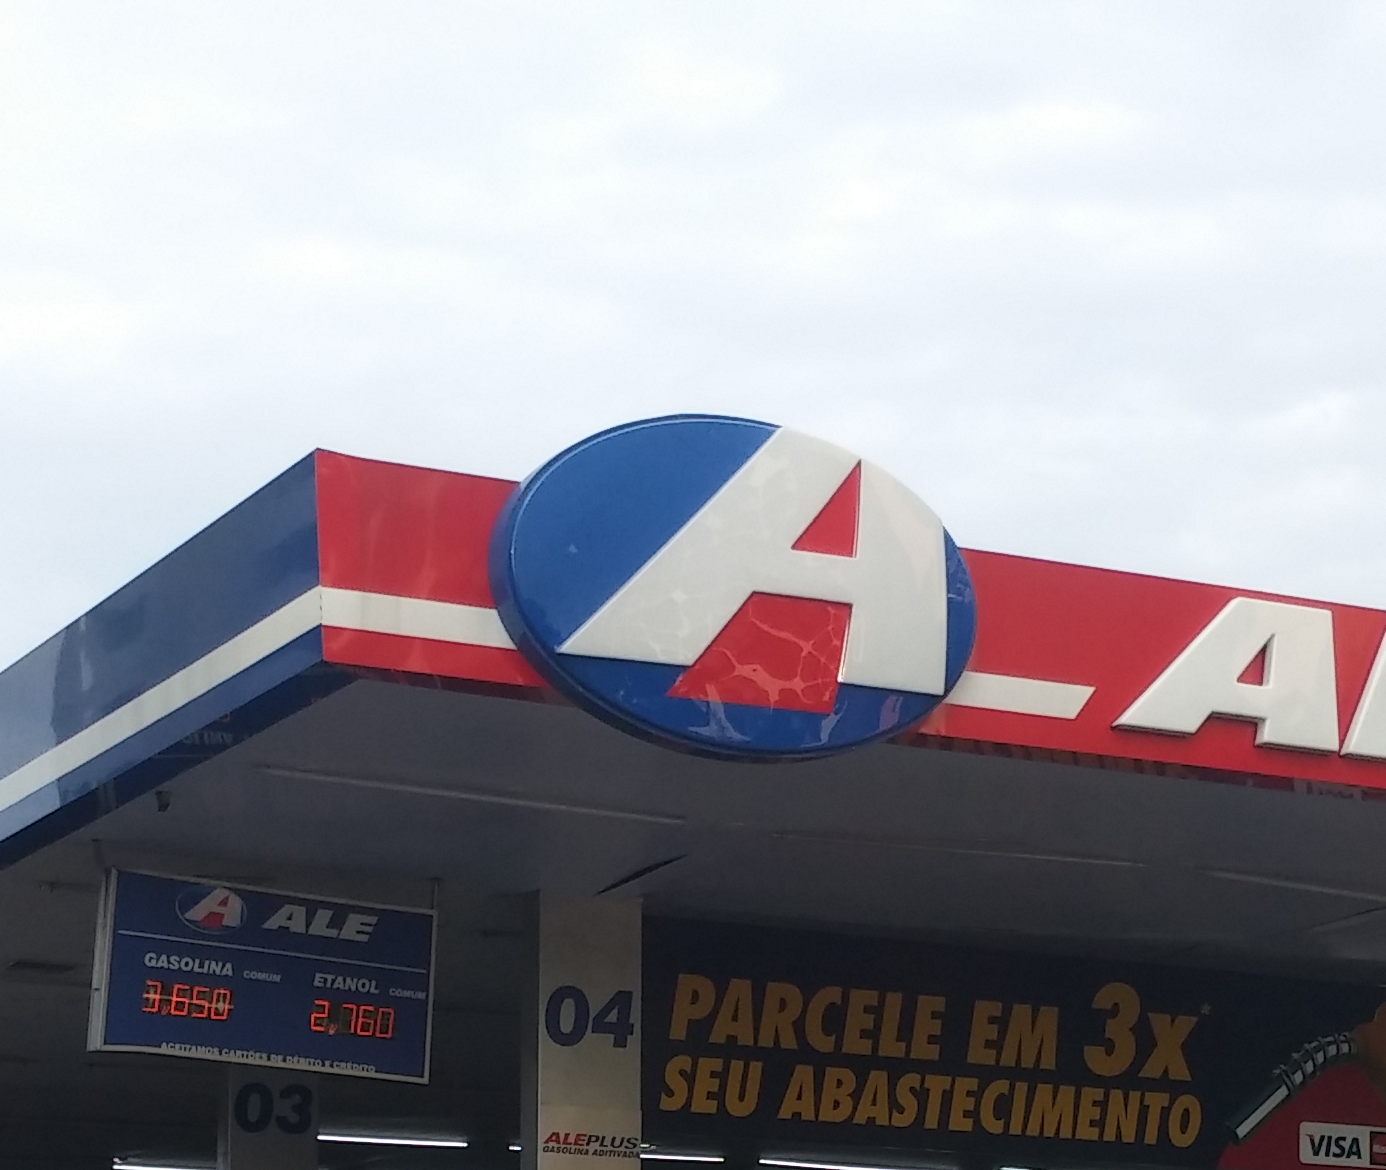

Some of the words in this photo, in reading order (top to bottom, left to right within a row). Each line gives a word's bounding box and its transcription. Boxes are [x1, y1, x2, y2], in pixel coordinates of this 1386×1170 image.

[261, 904, 379, 942] ALE
[144, 951, 234, 977] GASOLINA
[243, 969, 281, 983] COMUM
[314, 973, 380, 995] ETANOL
[389, 988, 427, 1000] COMUM
[545, 985, 634, 1048] 04
[668, 973, 943, 1061] PARCELE
[966, 1002, 1061, 1070] EM
[235, 1082, 312, 1134] 03
[658, 1055, 764, 1119] SEU
[777, 1065, 1203, 1149] ABASTECIMENTO
[543, 1146, 589, 1157] GASOLINA
[592, 1148, 640, 1159] ADITIVADA
[544, 1131, 640, 1151] ALEPLUS
[1306, 1134, 1362, 1159] VISA
